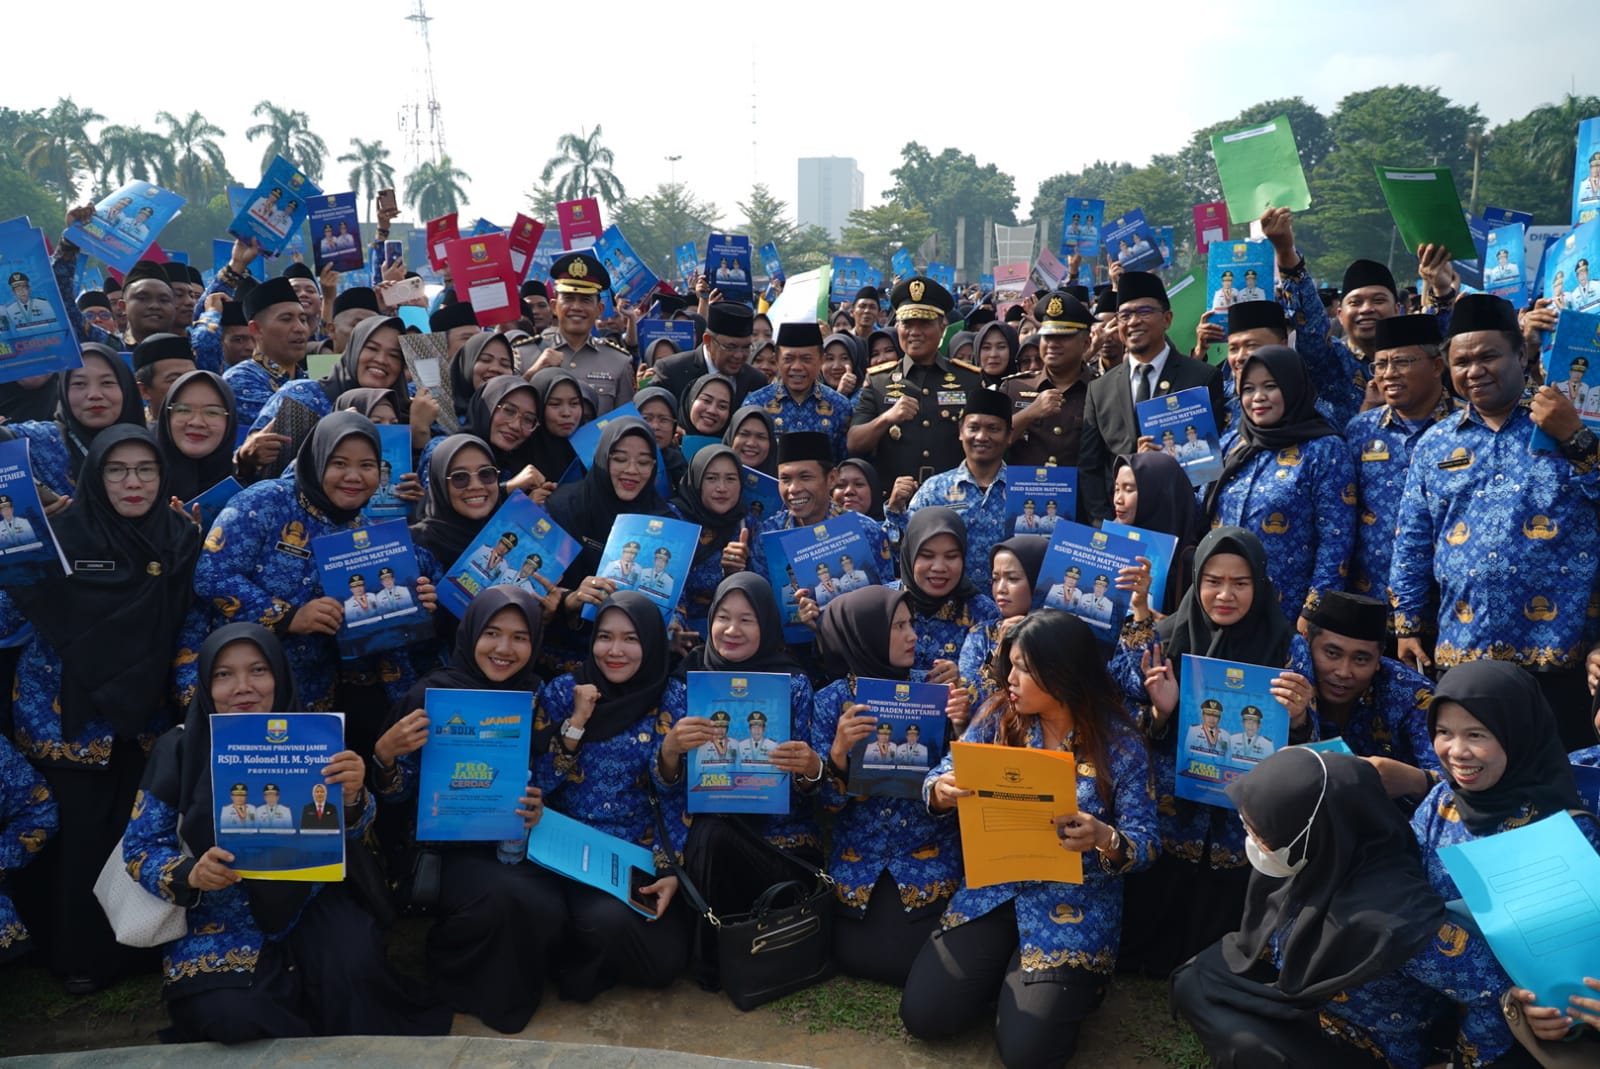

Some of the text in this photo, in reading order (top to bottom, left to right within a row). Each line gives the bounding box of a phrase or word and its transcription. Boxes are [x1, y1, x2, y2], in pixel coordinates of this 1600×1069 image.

[324, 546, 408, 571] RSUD RADEN MATTAHER
[1054, 545, 1072, 555] RSUD
[1072, 550, 1096, 561] RADEN
[879, 706, 903, 714] RADEN
[903, 708, 941, 717] MATTAHER
[305, 744, 328, 752] JAMBI
[217, 754, 242, 766] RSJD.
[243, 754, 279, 764] Kolonel
[280, 755, 291, 764] H.
[291, 755, 303, 764] M.
[451, 780, 491, 788] CERDAS
[734, 775, 777, 787] CERDAS
